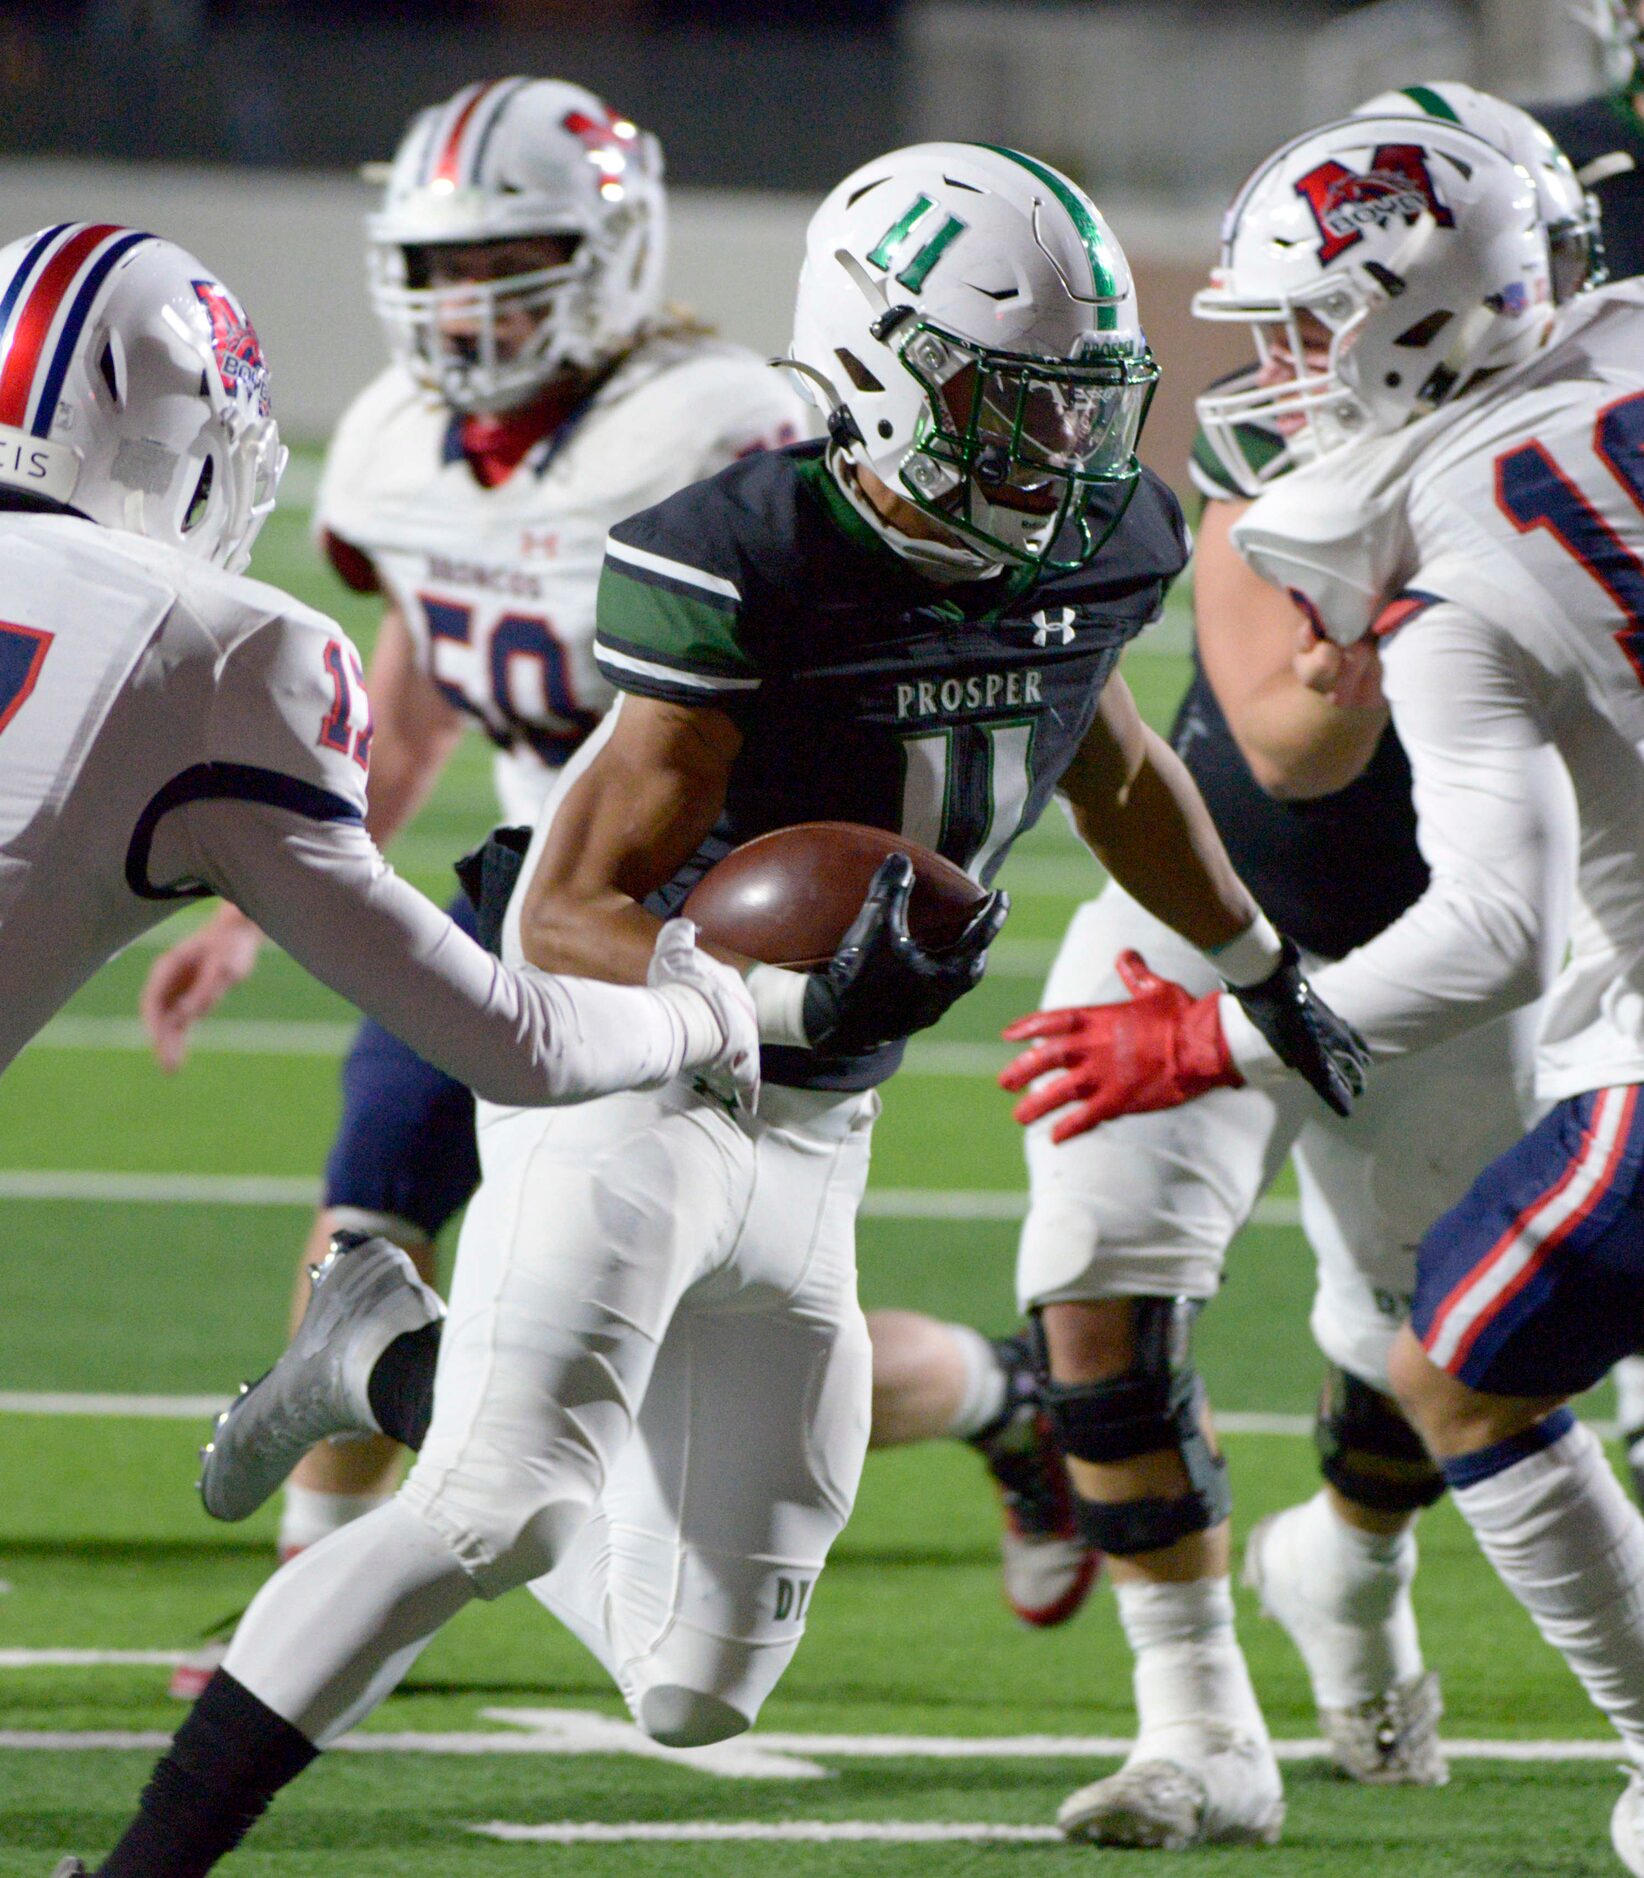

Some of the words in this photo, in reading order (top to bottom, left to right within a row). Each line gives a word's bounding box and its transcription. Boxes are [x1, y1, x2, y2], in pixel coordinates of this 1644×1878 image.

[1294, 143, 1456, 268] M
[898, 671, 1043, 719] PROSPER
[898, 717, 1038, 886] 11
